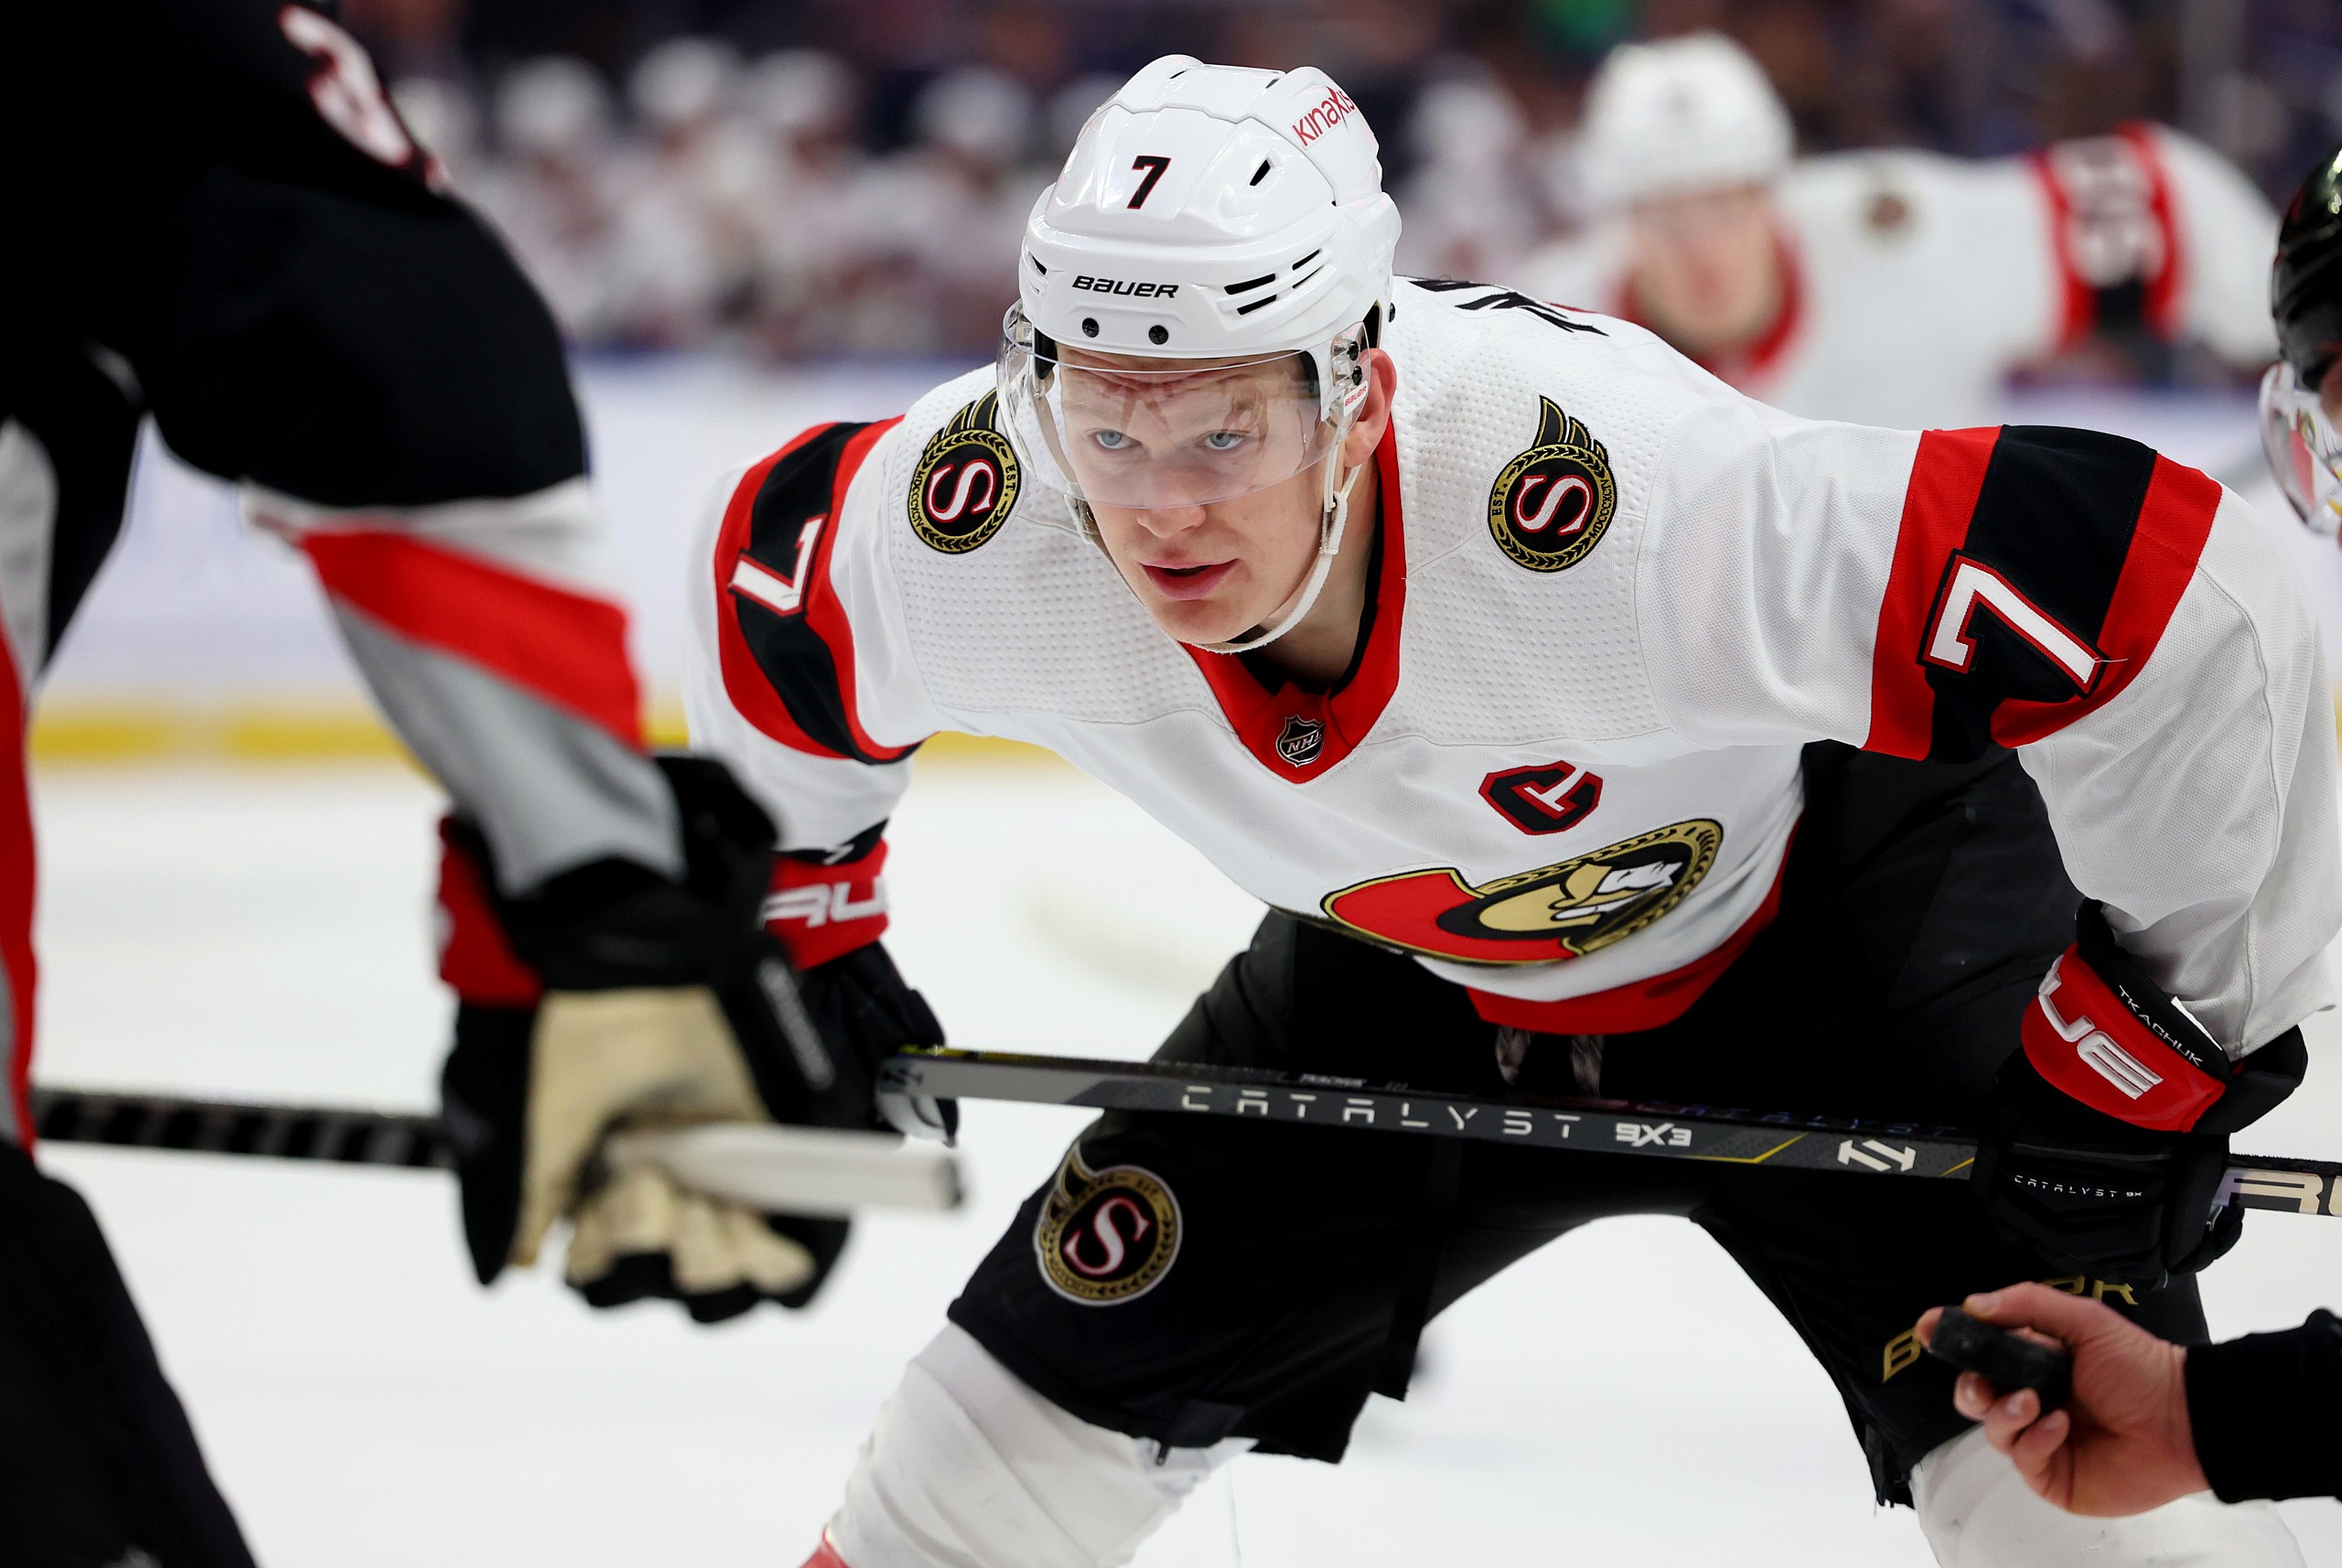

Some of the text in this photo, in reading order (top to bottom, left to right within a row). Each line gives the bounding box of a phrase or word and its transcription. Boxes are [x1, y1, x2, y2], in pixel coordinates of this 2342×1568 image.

[1126, 155, 1171, 209] 7
[1071, 274, 1179, 298] BAUER
[926, 458, 998, 523] S
[1513, 474, 1594, 535] S
[727, 512, 828, 618] 7
[1922, 554, 2103, 694] 7
[1287, 731, 1322, 754] NHL
[1478, 760, 1603, 835] C
[2038, 954, 2165, 1101] UE
[2119, 984, 2203, 1067] TKACHUK
[1182, 1085, 1582, 1138] CATALYST
[2014, 1175, 2118, 1198] CATALYST
[1063, 1197, 1153, 1275] S
